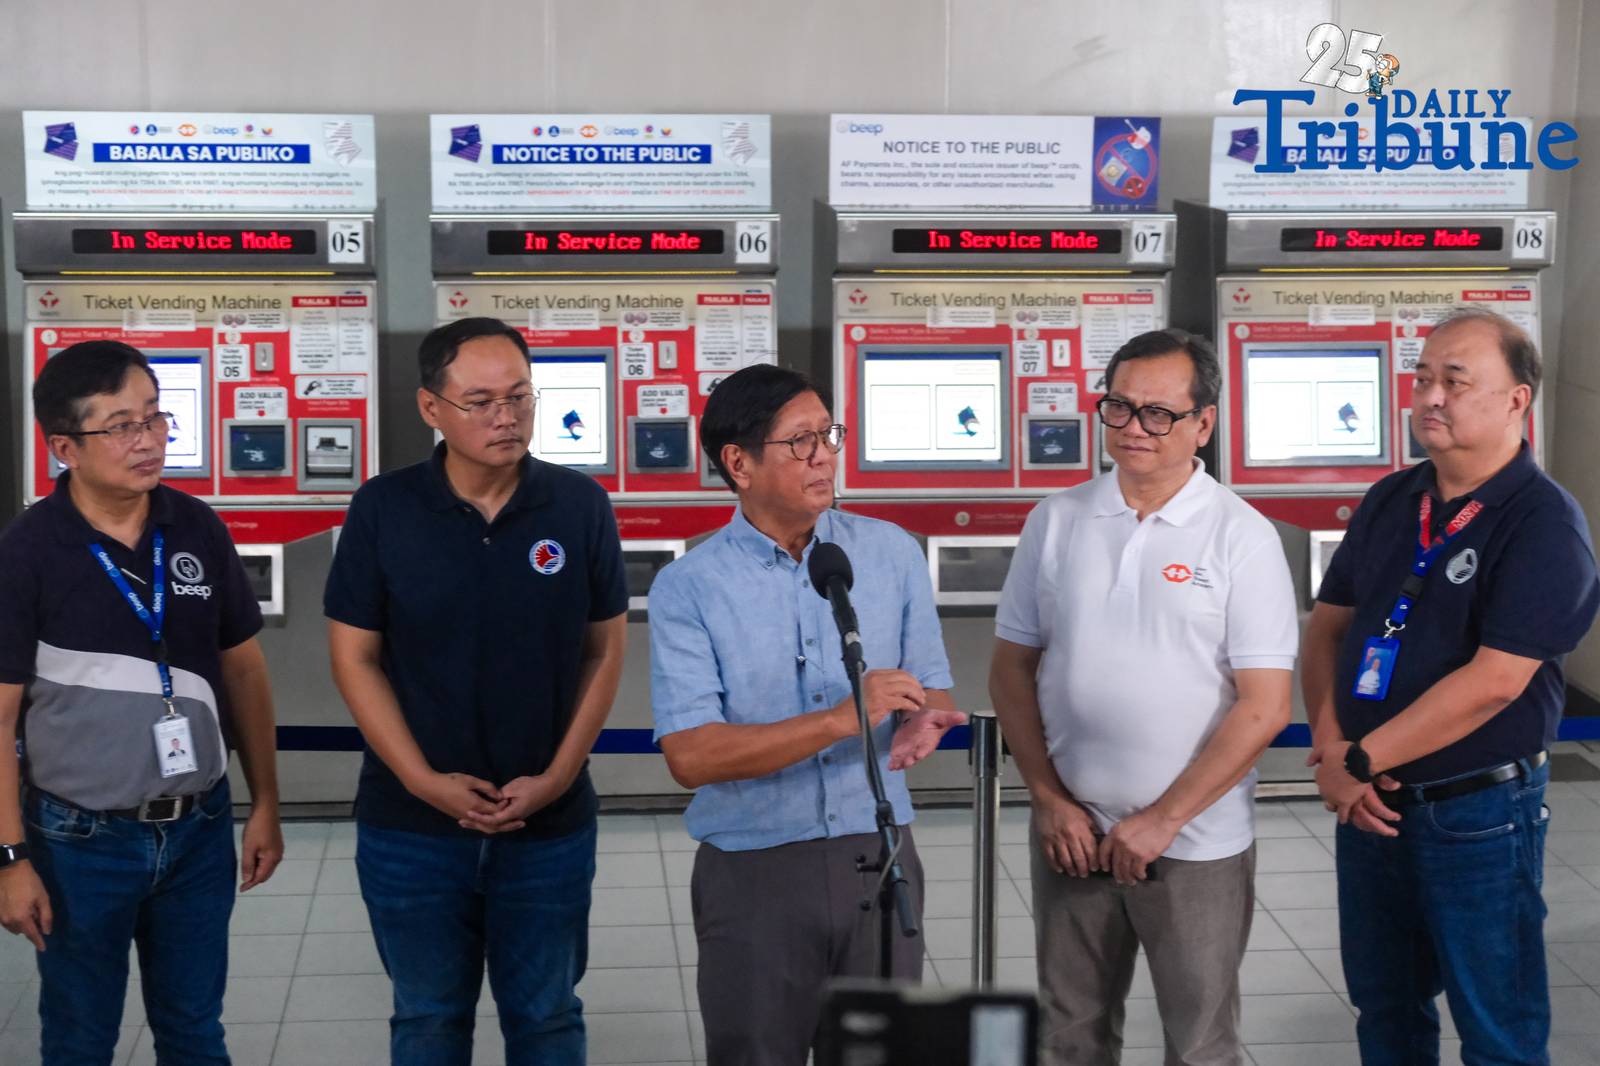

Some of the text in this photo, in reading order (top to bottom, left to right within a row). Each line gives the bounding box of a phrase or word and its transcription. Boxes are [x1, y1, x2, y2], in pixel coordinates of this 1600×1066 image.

[849, 122, 883, 136] beep
[109, 146, 296, 162] BABALA SA PUBLIKO
[502, 147, 702, 162] NOTICE TO THE PUBLIC
[883, 141, 1061, 154] NOTICE TO THE PUBLIC
[111, 232, 292, 250] In Service Mode
[332, 232, 361, 253] 05
[524, 233, 701, 250] In Service Mode
[739, 232, 767, 253] 06
[928, 231, 1099, 249] In Service Mode
[1135, 232, 1162, 252] 07
[1314, 229, 1481, 247] In Service Mode
[1516, 228, 1542, 248] 08
[83, 294, 282, 312] Ticket Vending Machine
[492, 294, 684, 312] Ticket Vending Machine
[890, 291, 1077, 310] Ticket Vending Machine
[1272, 291, 1454, 307] Ticket Vending Machine
[223, 366, 240, 377] 05
[628, 365, 644, 375] 06
[1022, 362, 1038, 372] 07
[171, 581, 212, 600] beep
[152, 592, 162, 613] beep
